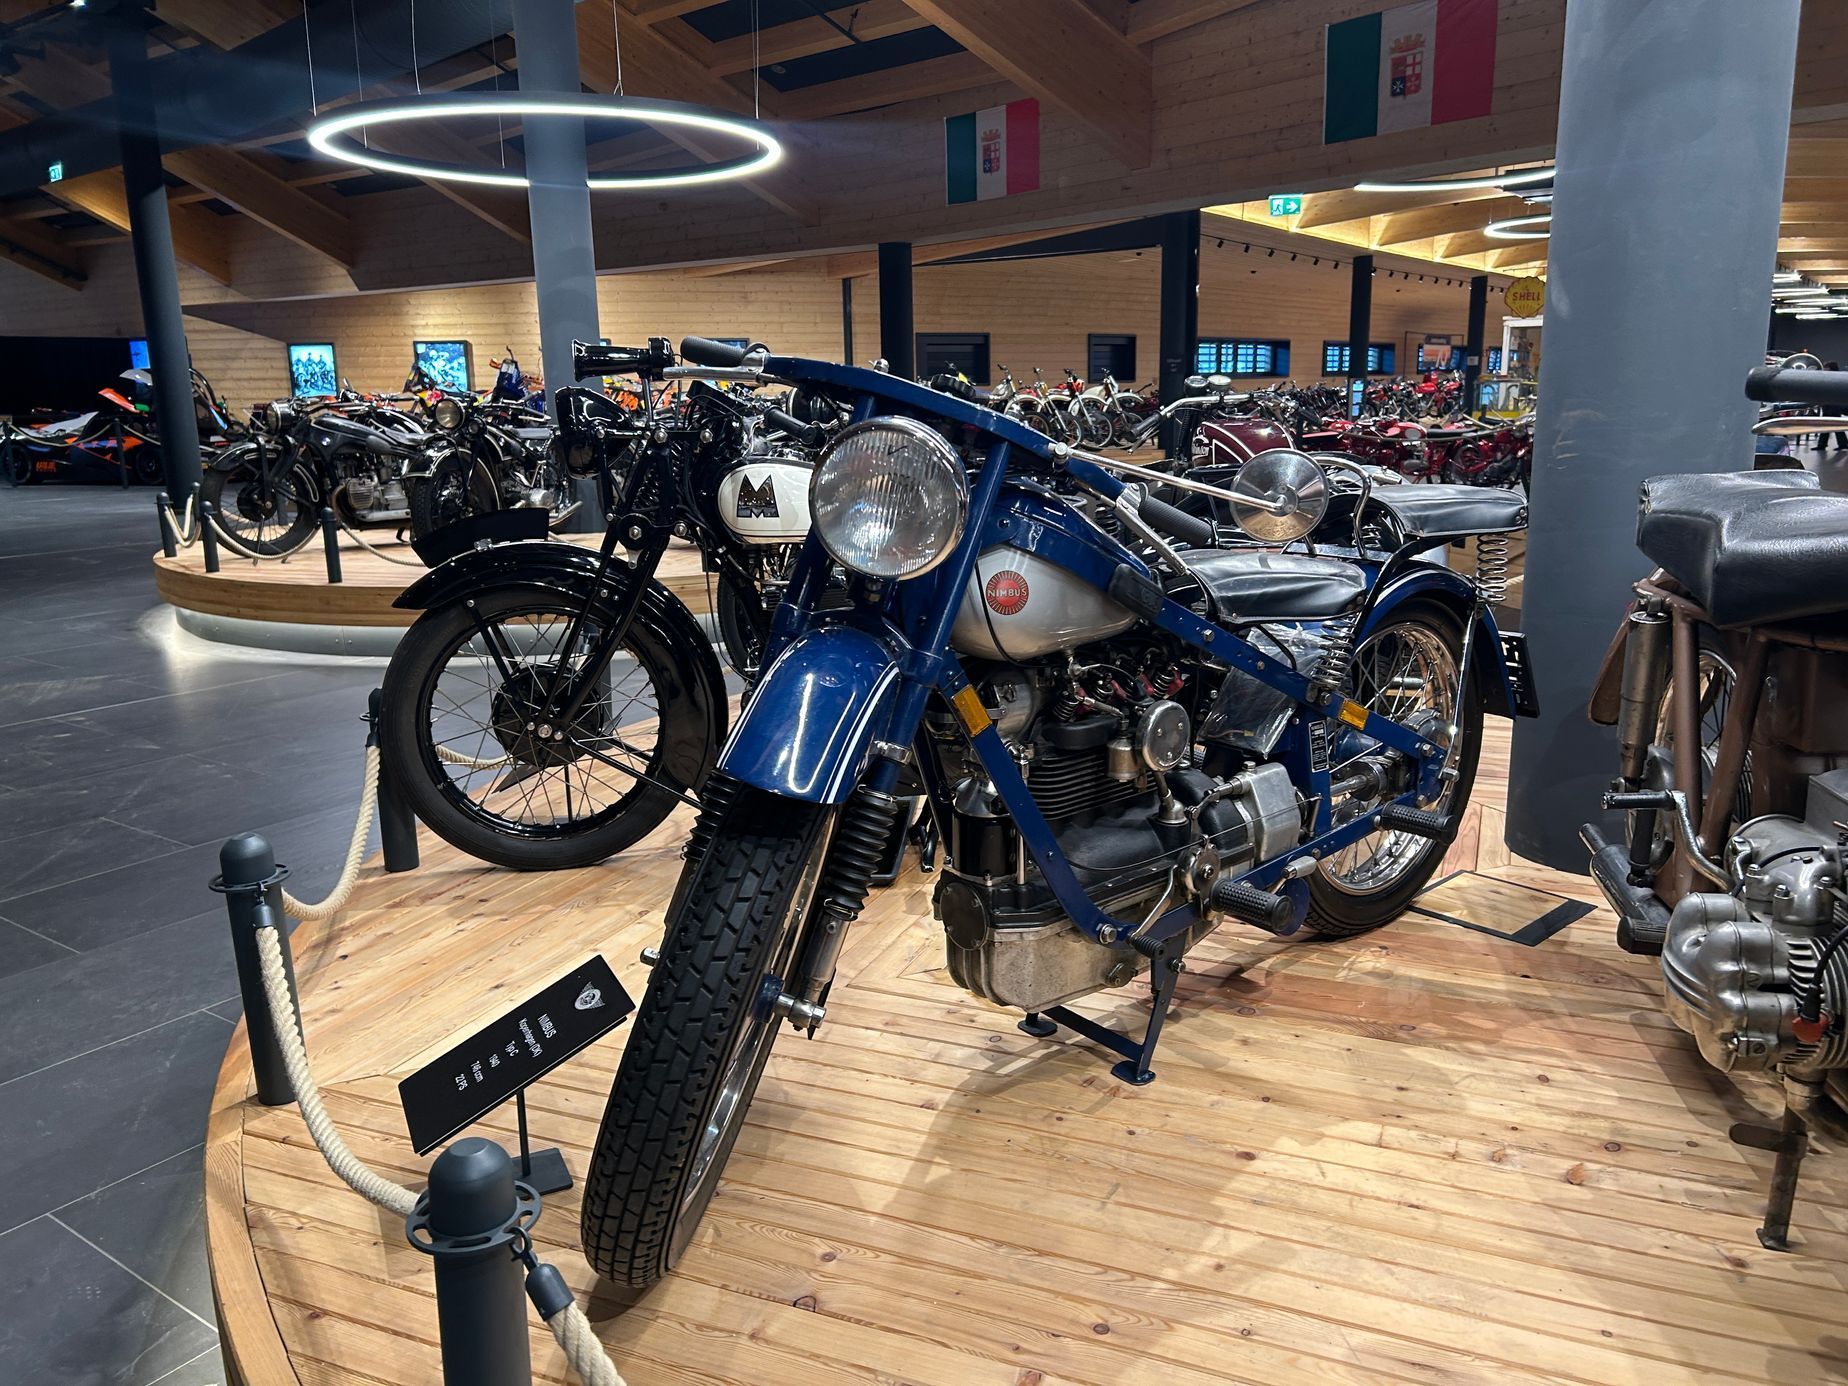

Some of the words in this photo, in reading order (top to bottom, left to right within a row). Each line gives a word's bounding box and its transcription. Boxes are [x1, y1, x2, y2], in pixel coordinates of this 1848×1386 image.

[1512, 291, 1541, 301] SHELL
[736, 473, 780, 519] M
[988, 588, 1027, 597] NIMBUS
[537, 1013, 557, 1039] NIMBUS
[509, 1049, 519, 1057] C
[455, 1073, 465, 1084] 22
[457, 1078, 468, 1091] PS
